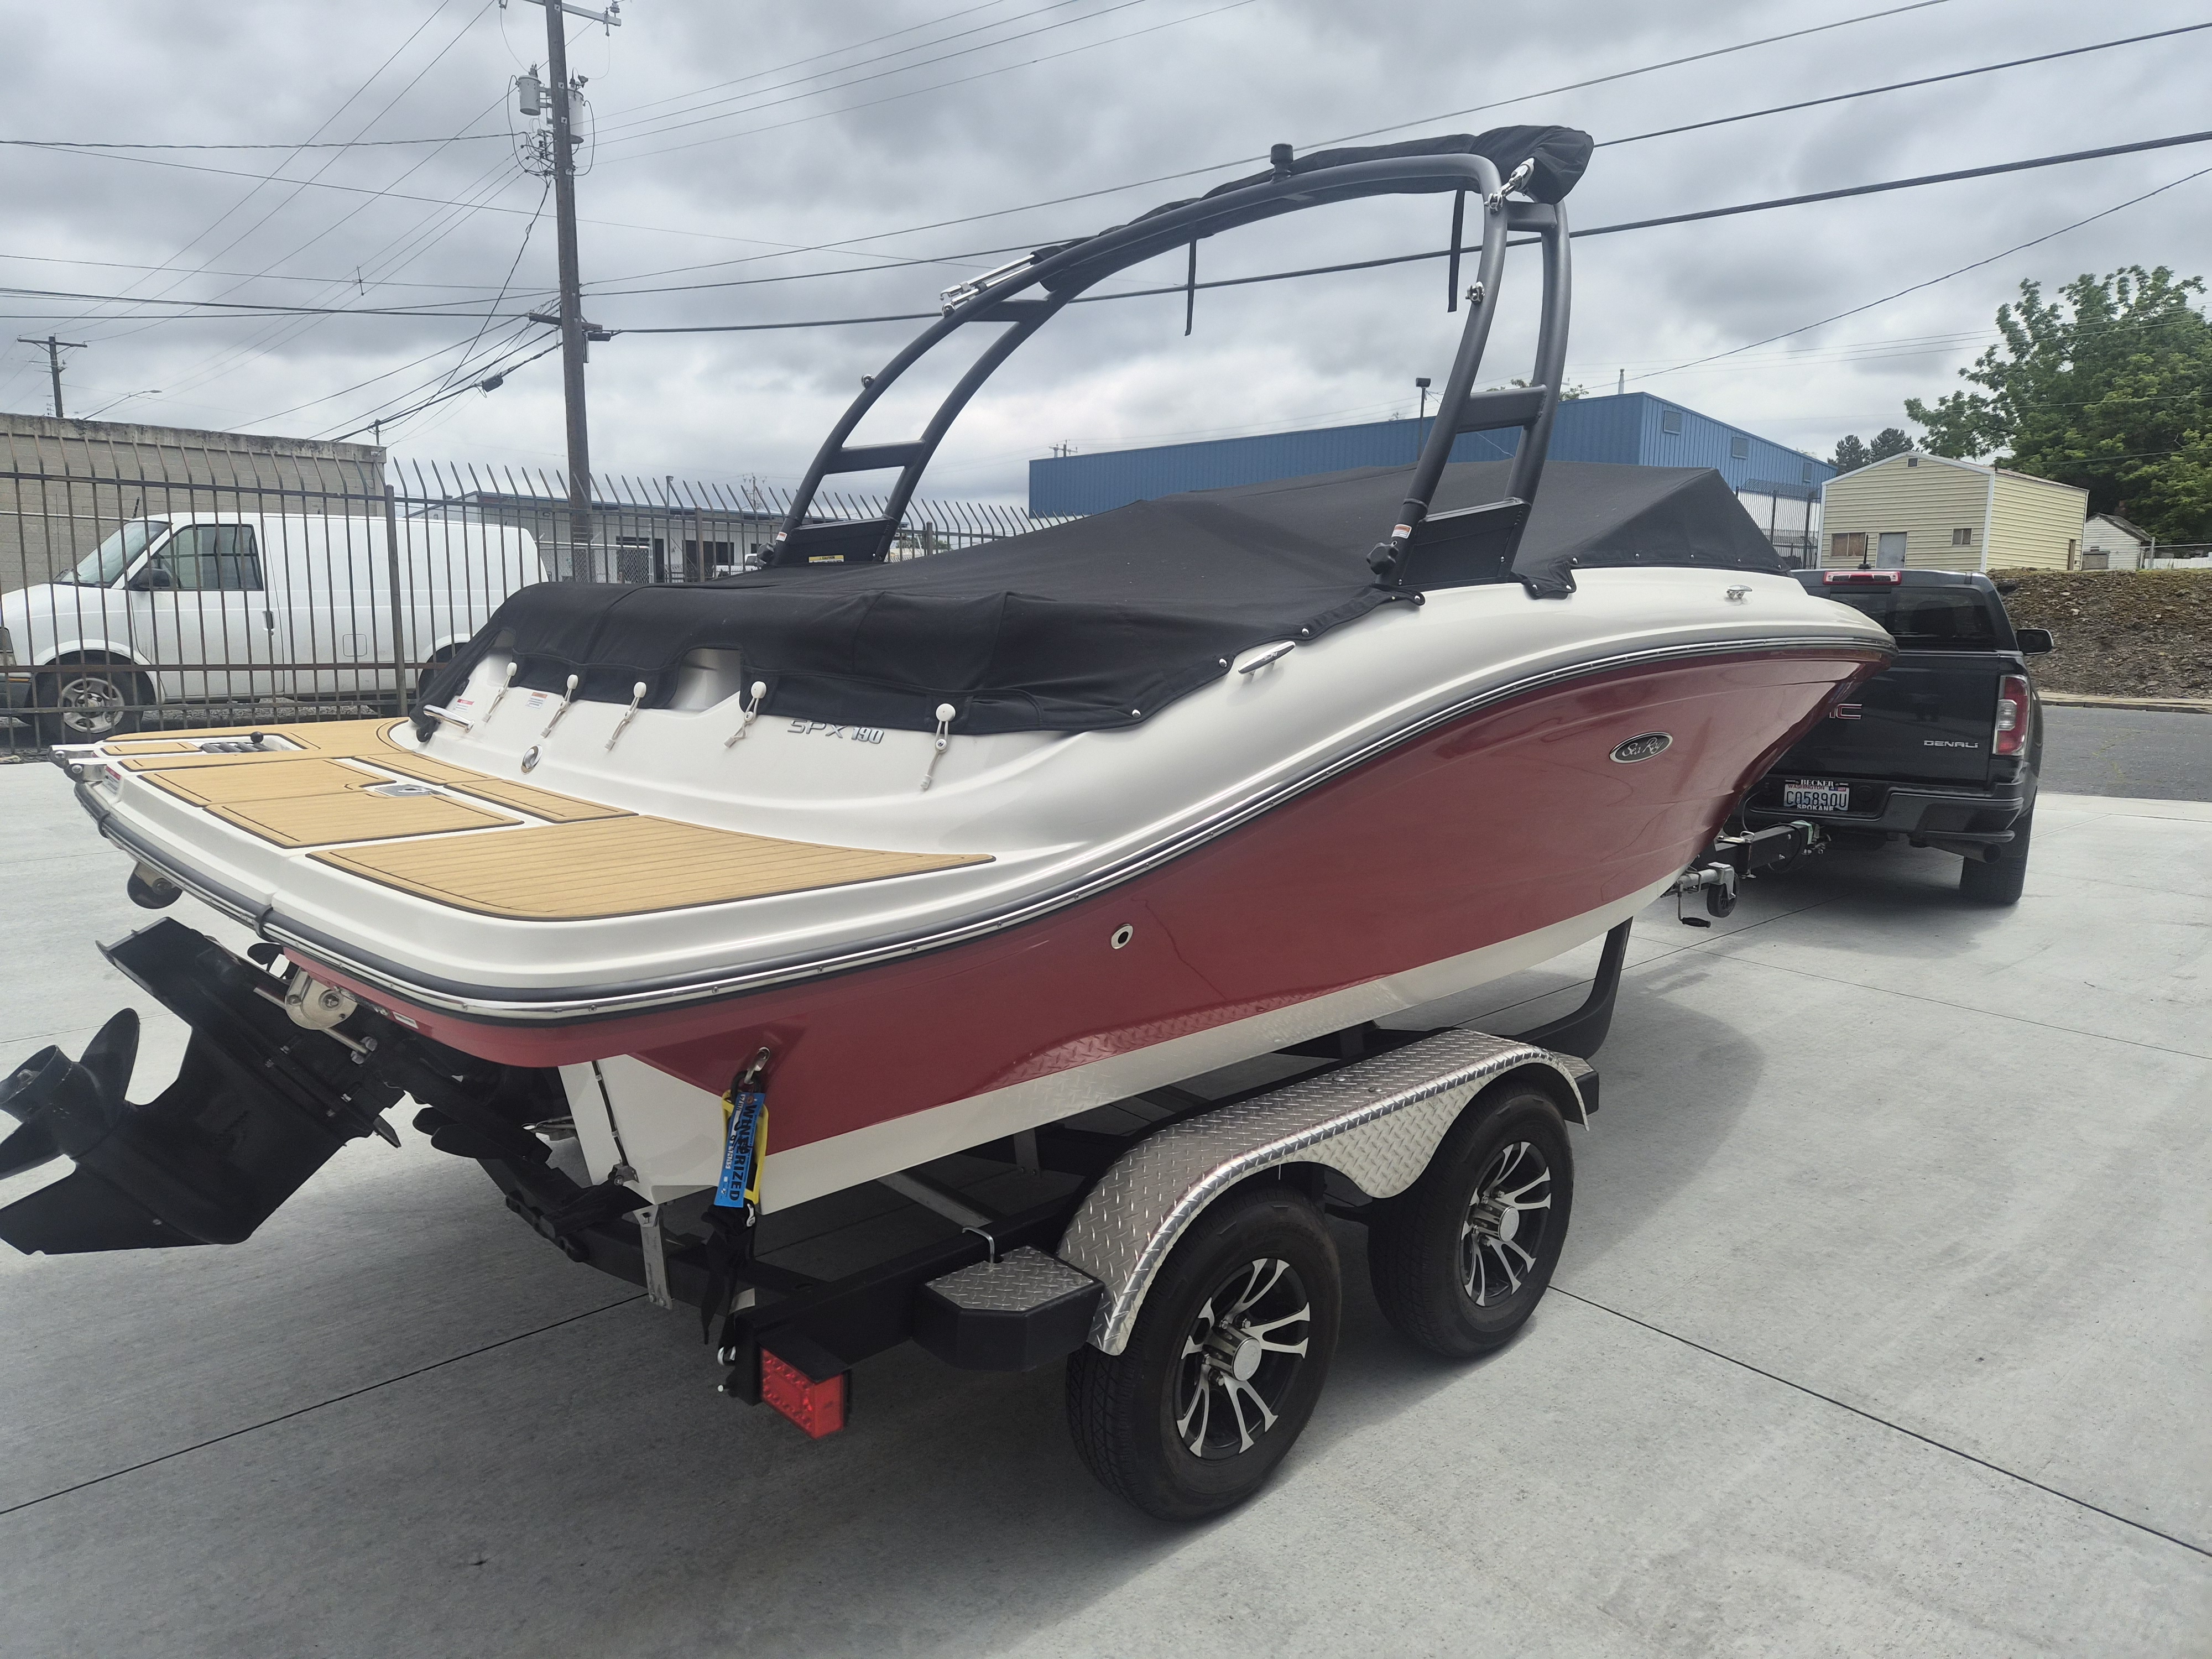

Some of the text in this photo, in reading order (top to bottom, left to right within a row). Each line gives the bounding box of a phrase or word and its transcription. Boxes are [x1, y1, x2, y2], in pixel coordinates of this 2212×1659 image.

[787, 719, 884, 744] SPX 190
[1622, 737, 1664, 757] Sea Ray
